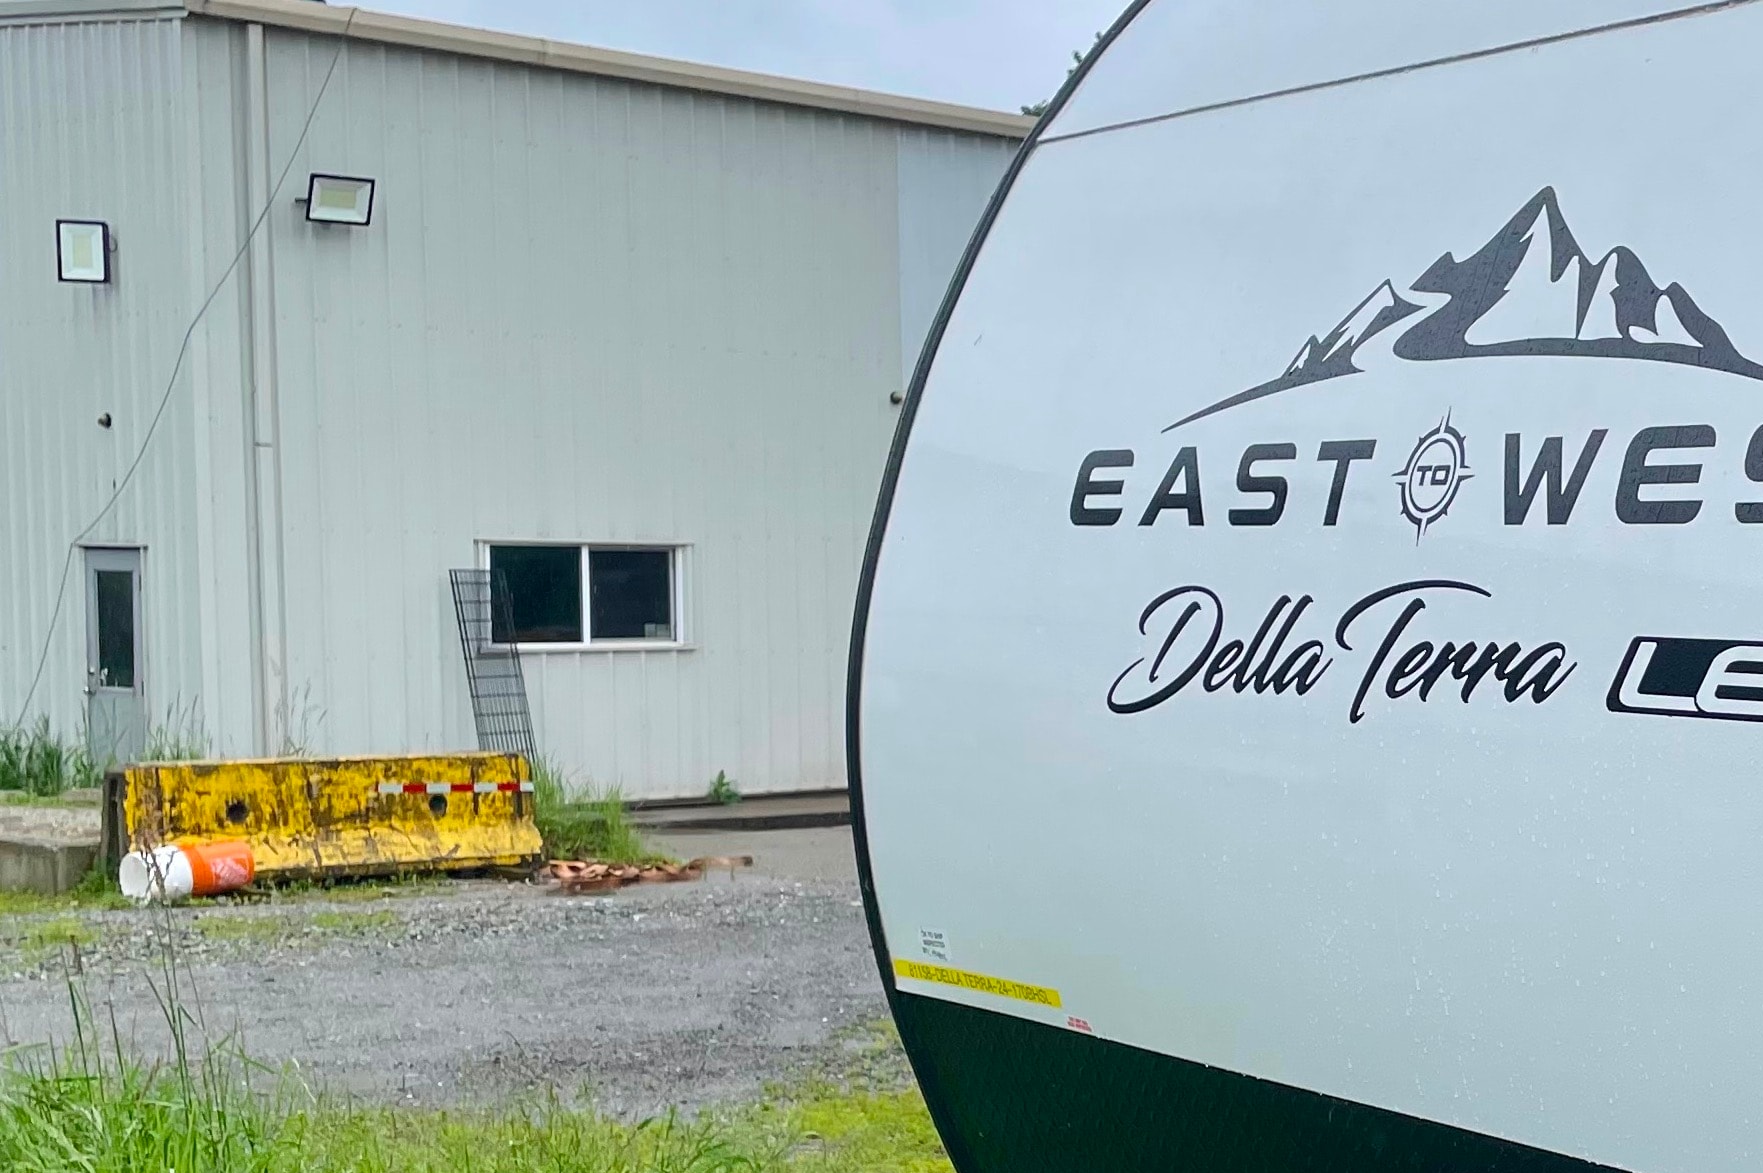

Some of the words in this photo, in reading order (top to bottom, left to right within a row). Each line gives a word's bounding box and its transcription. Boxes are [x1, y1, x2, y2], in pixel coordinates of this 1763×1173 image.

[1069, 438, 1377, 526] EAST
[1416, 465, 1451, 486] TO
[1106, 584, 1333, 715] Della
[1335, 578, 1578, 724] Terra
